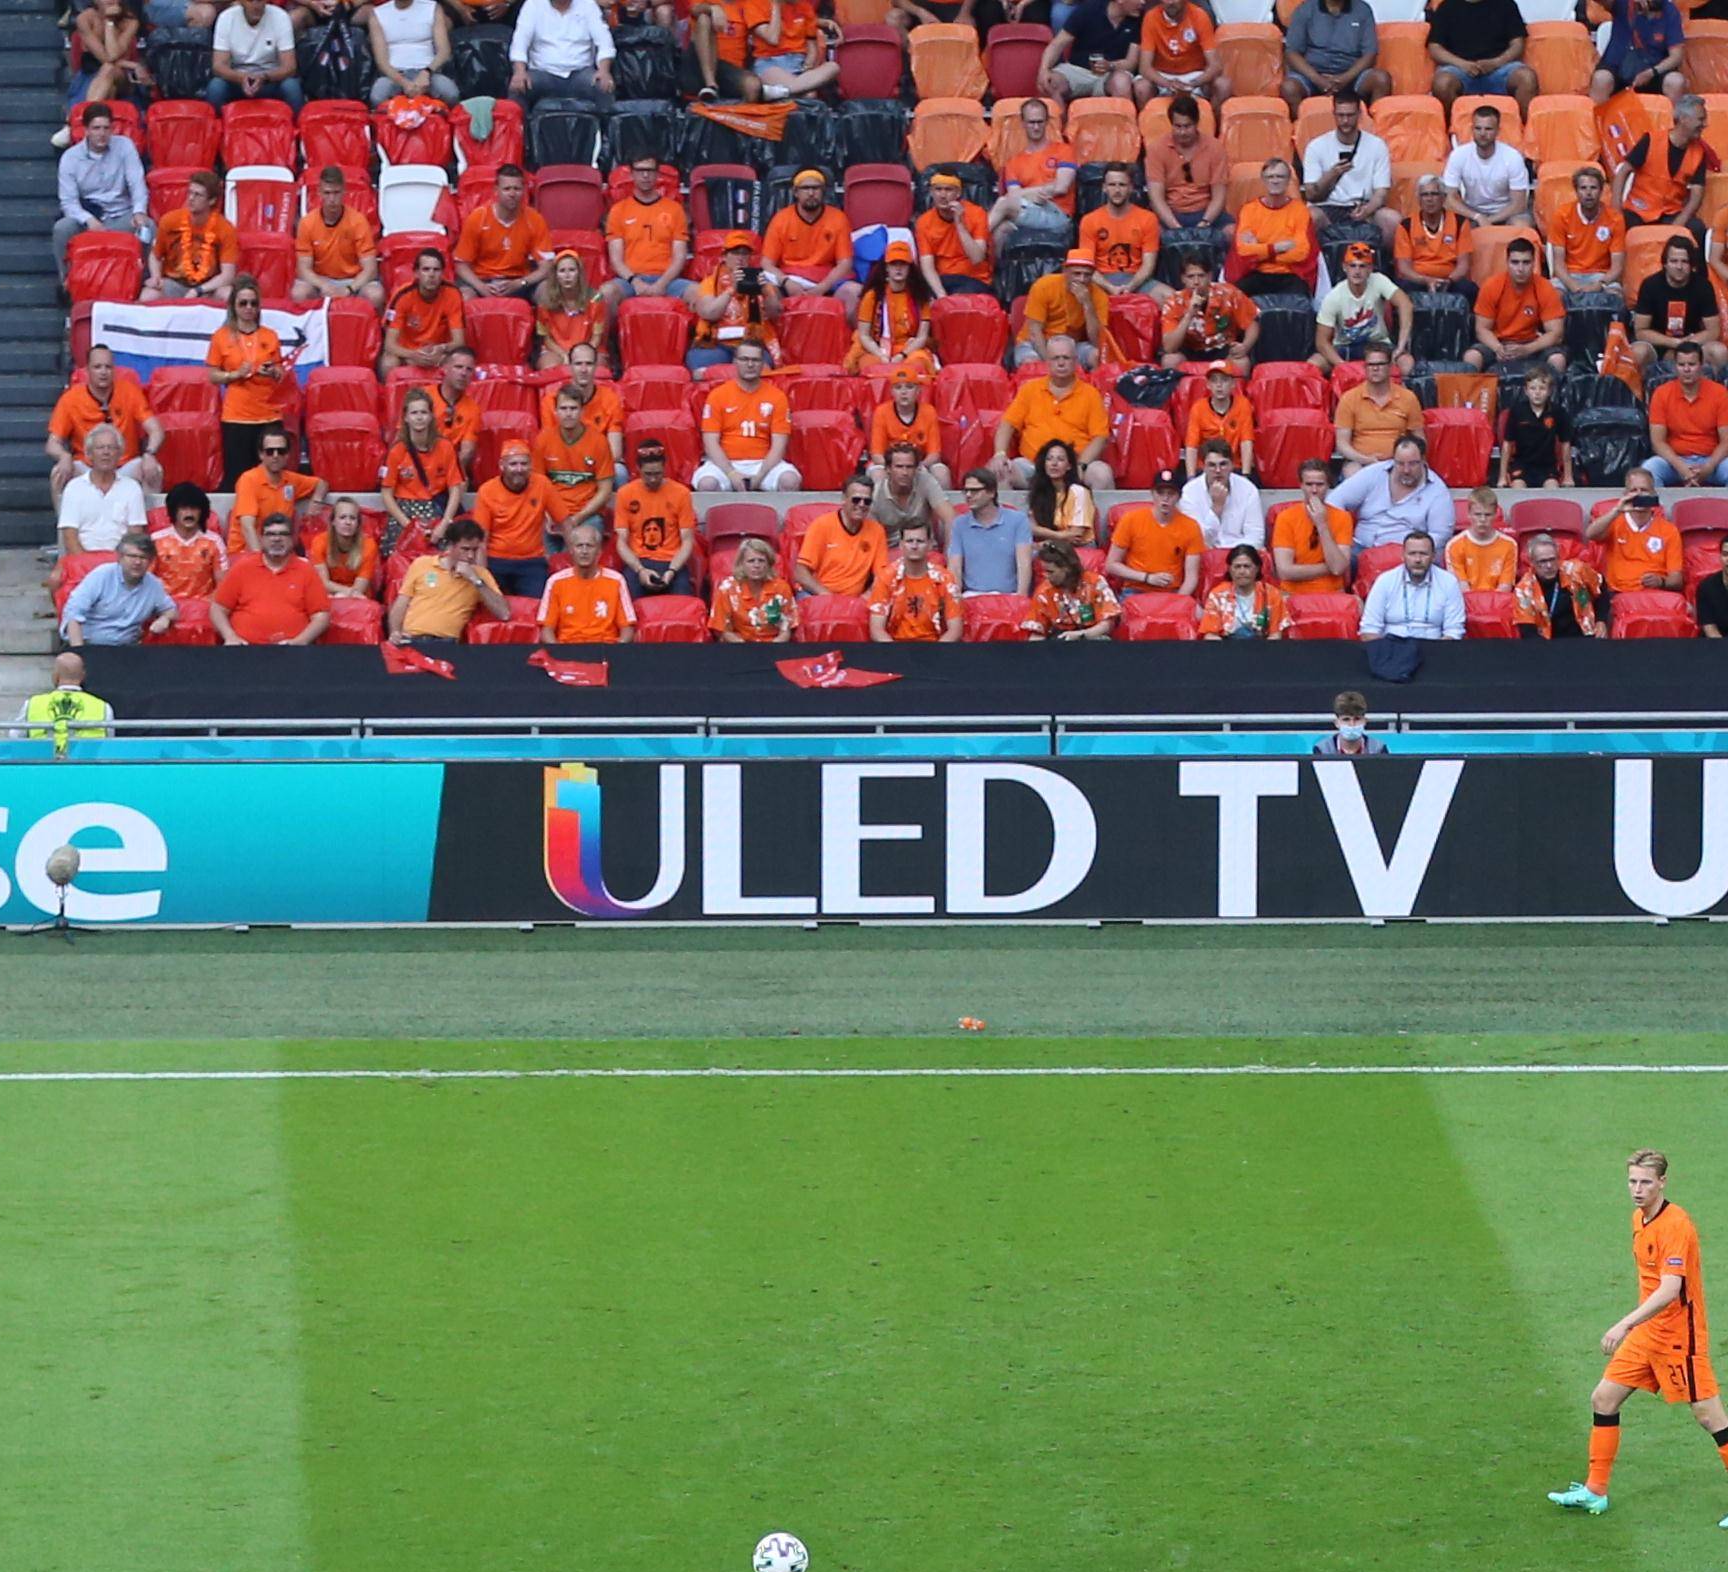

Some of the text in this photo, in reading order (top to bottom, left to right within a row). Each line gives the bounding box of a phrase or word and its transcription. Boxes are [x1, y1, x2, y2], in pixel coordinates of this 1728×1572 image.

[643, 225, 652, 242] 7
[741, 420, 756, 437] 11
[543, 761, 1098, 917] ULED
[1179, 760, 1465, 917] TV
[1668, 1364, 1687, 1387] 21
